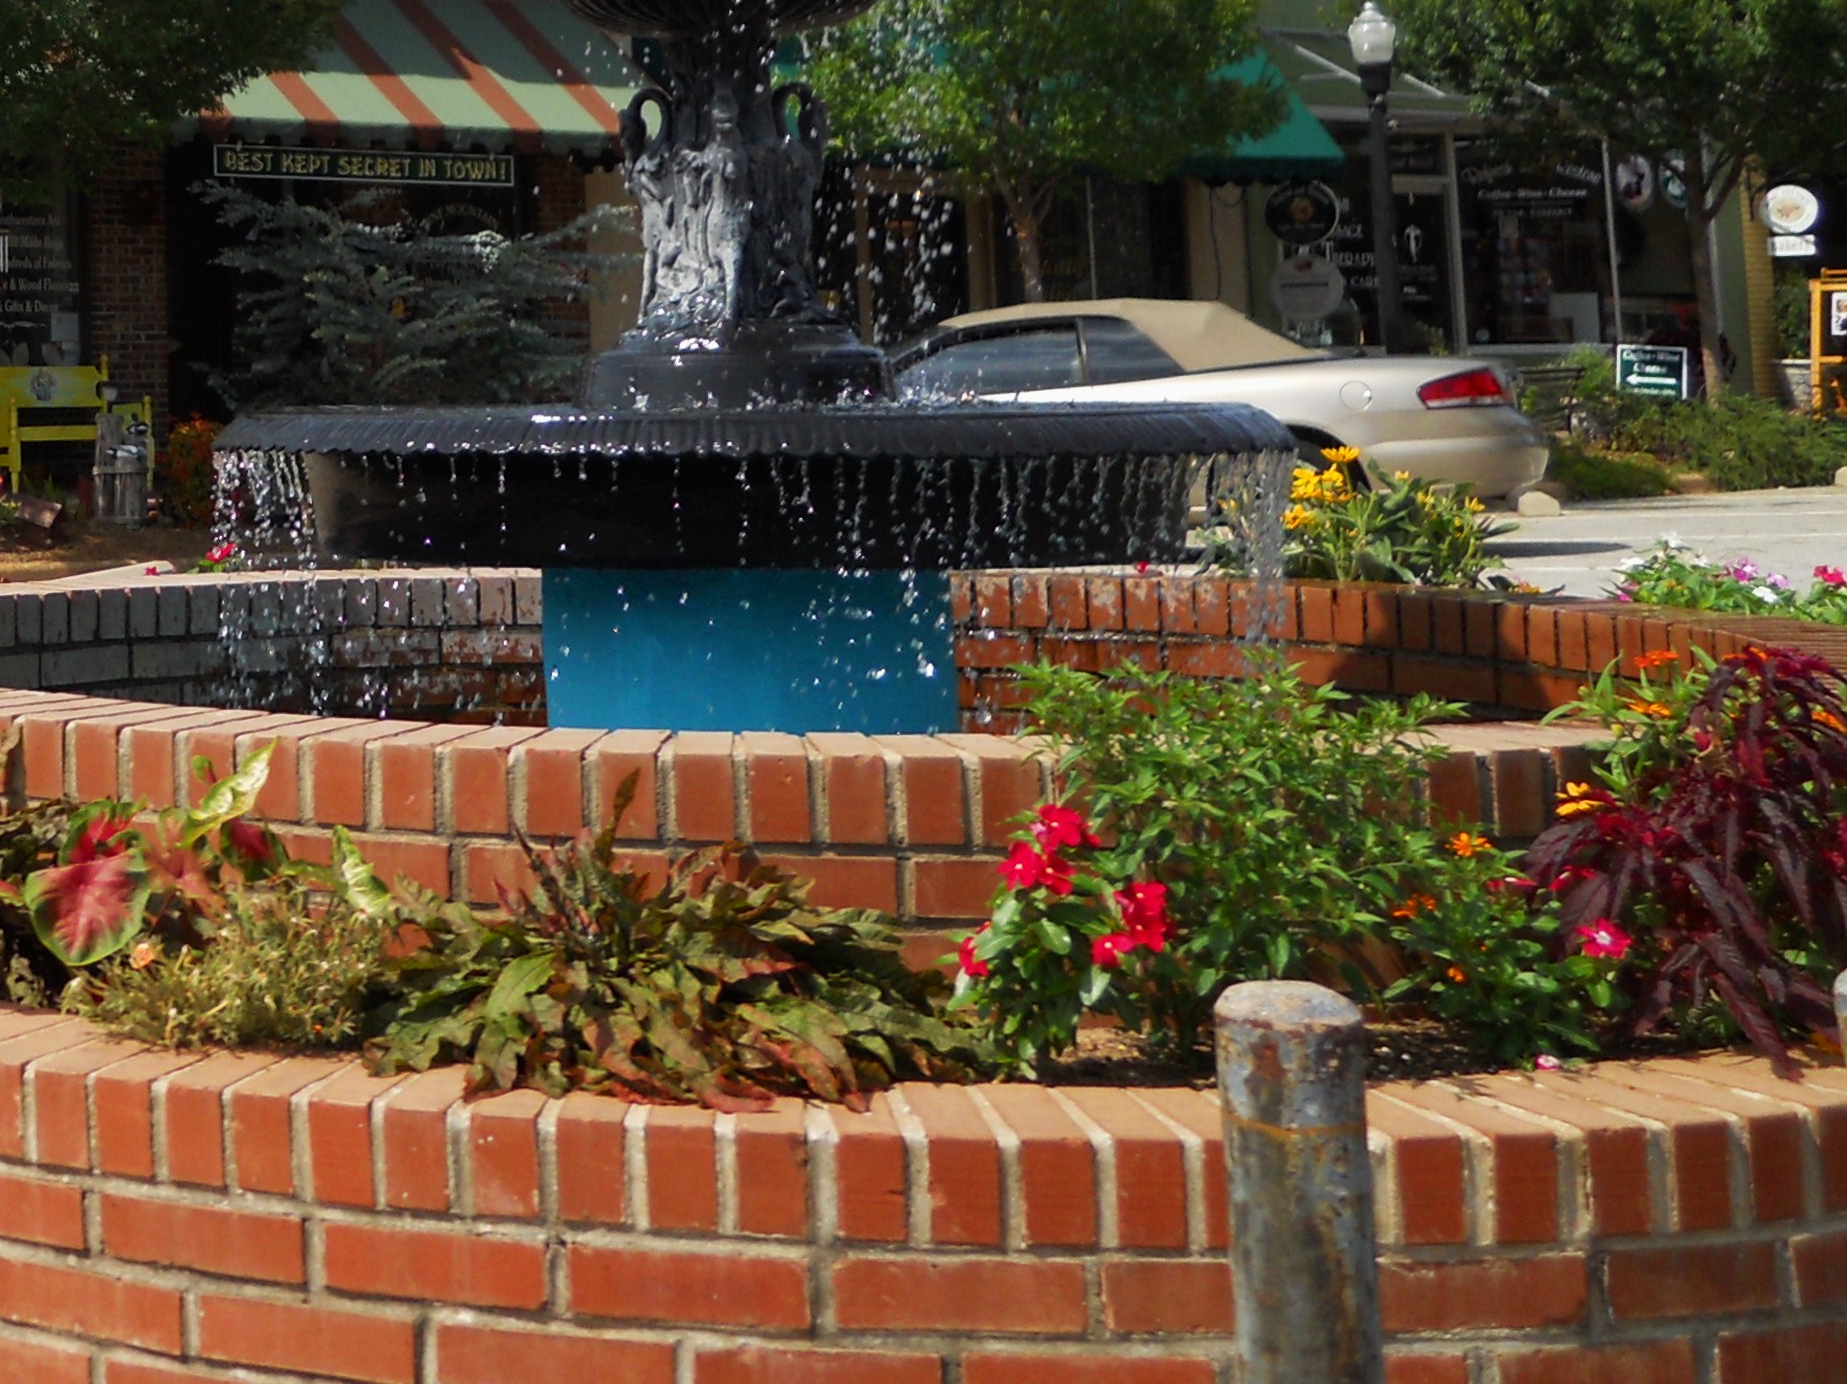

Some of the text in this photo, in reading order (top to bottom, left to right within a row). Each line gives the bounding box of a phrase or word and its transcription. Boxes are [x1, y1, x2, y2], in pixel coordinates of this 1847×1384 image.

[224, 150, 507, 180] BEST KEPT SECRET IN TOWN!
